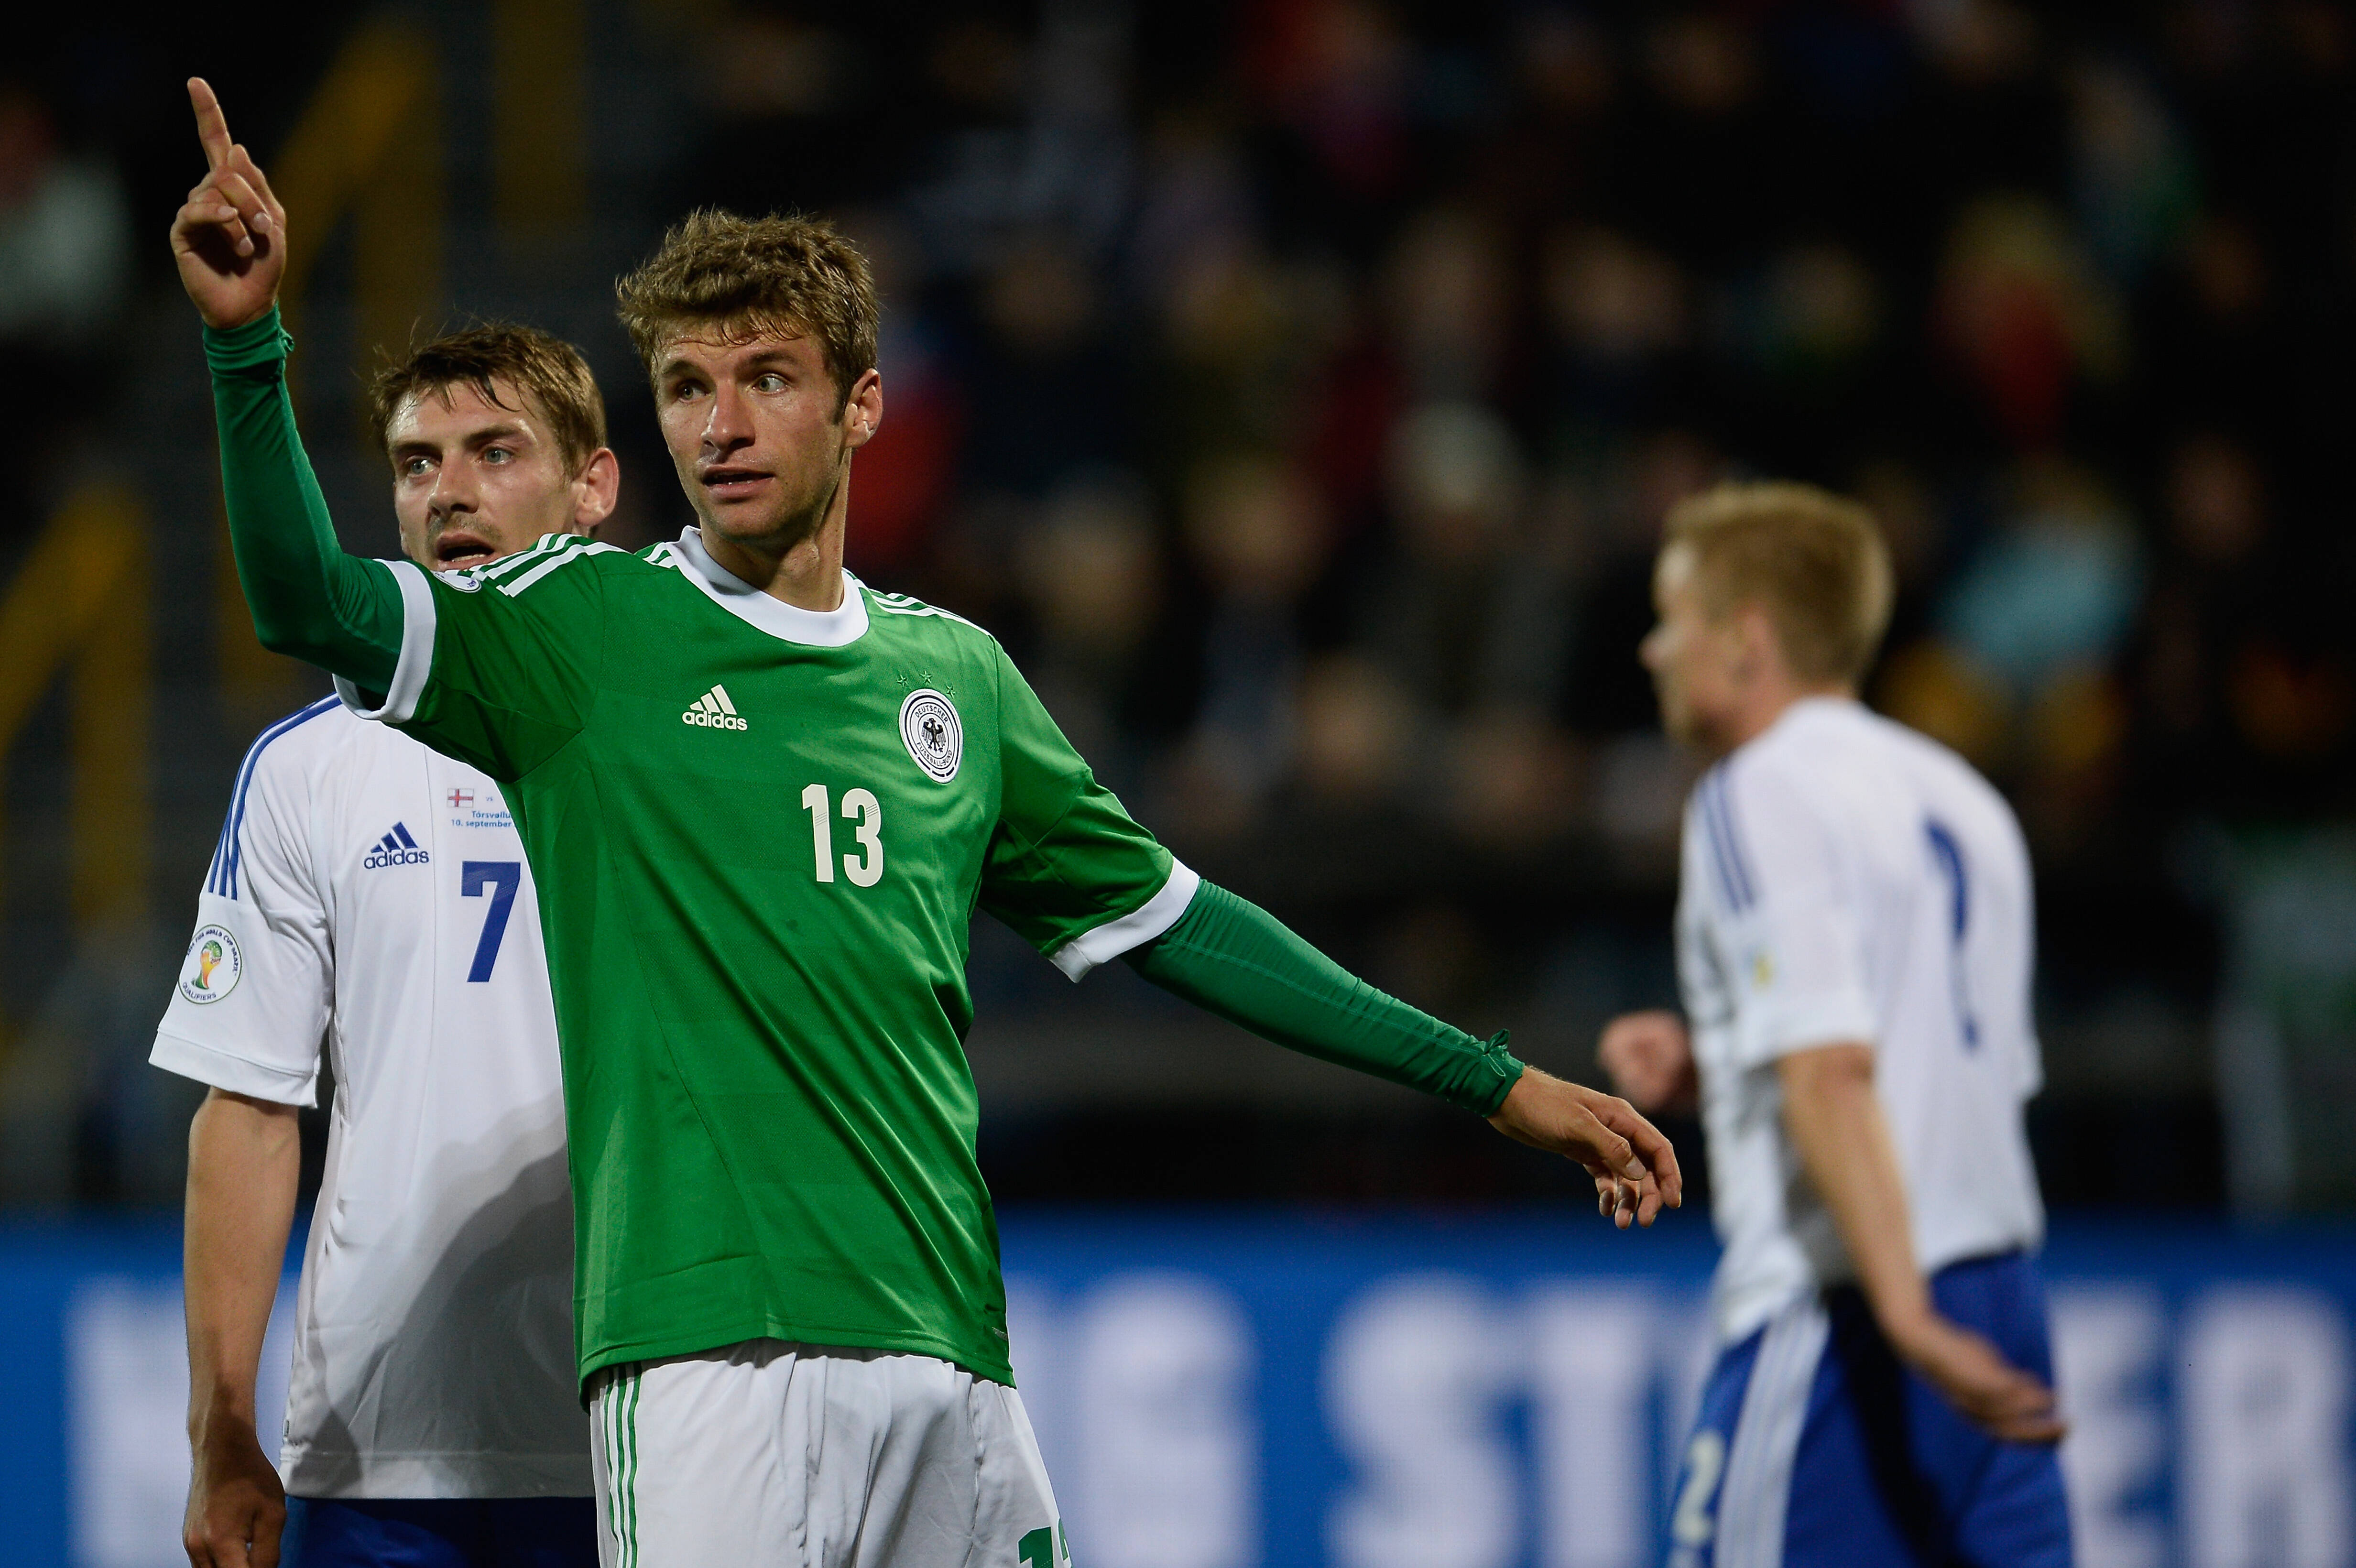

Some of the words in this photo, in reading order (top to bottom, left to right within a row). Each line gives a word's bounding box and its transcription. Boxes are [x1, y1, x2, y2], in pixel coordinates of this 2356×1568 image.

[682, 710, 748, 730] adidas
[915, 705, 948, 723] DEUTSCHER
[802, 784, 884, 887] 13
[364, 849, 429, 869] adidas
[461, 860, 521, 982] 7
[183, 982, 216, 1000] QUALIFIERS
